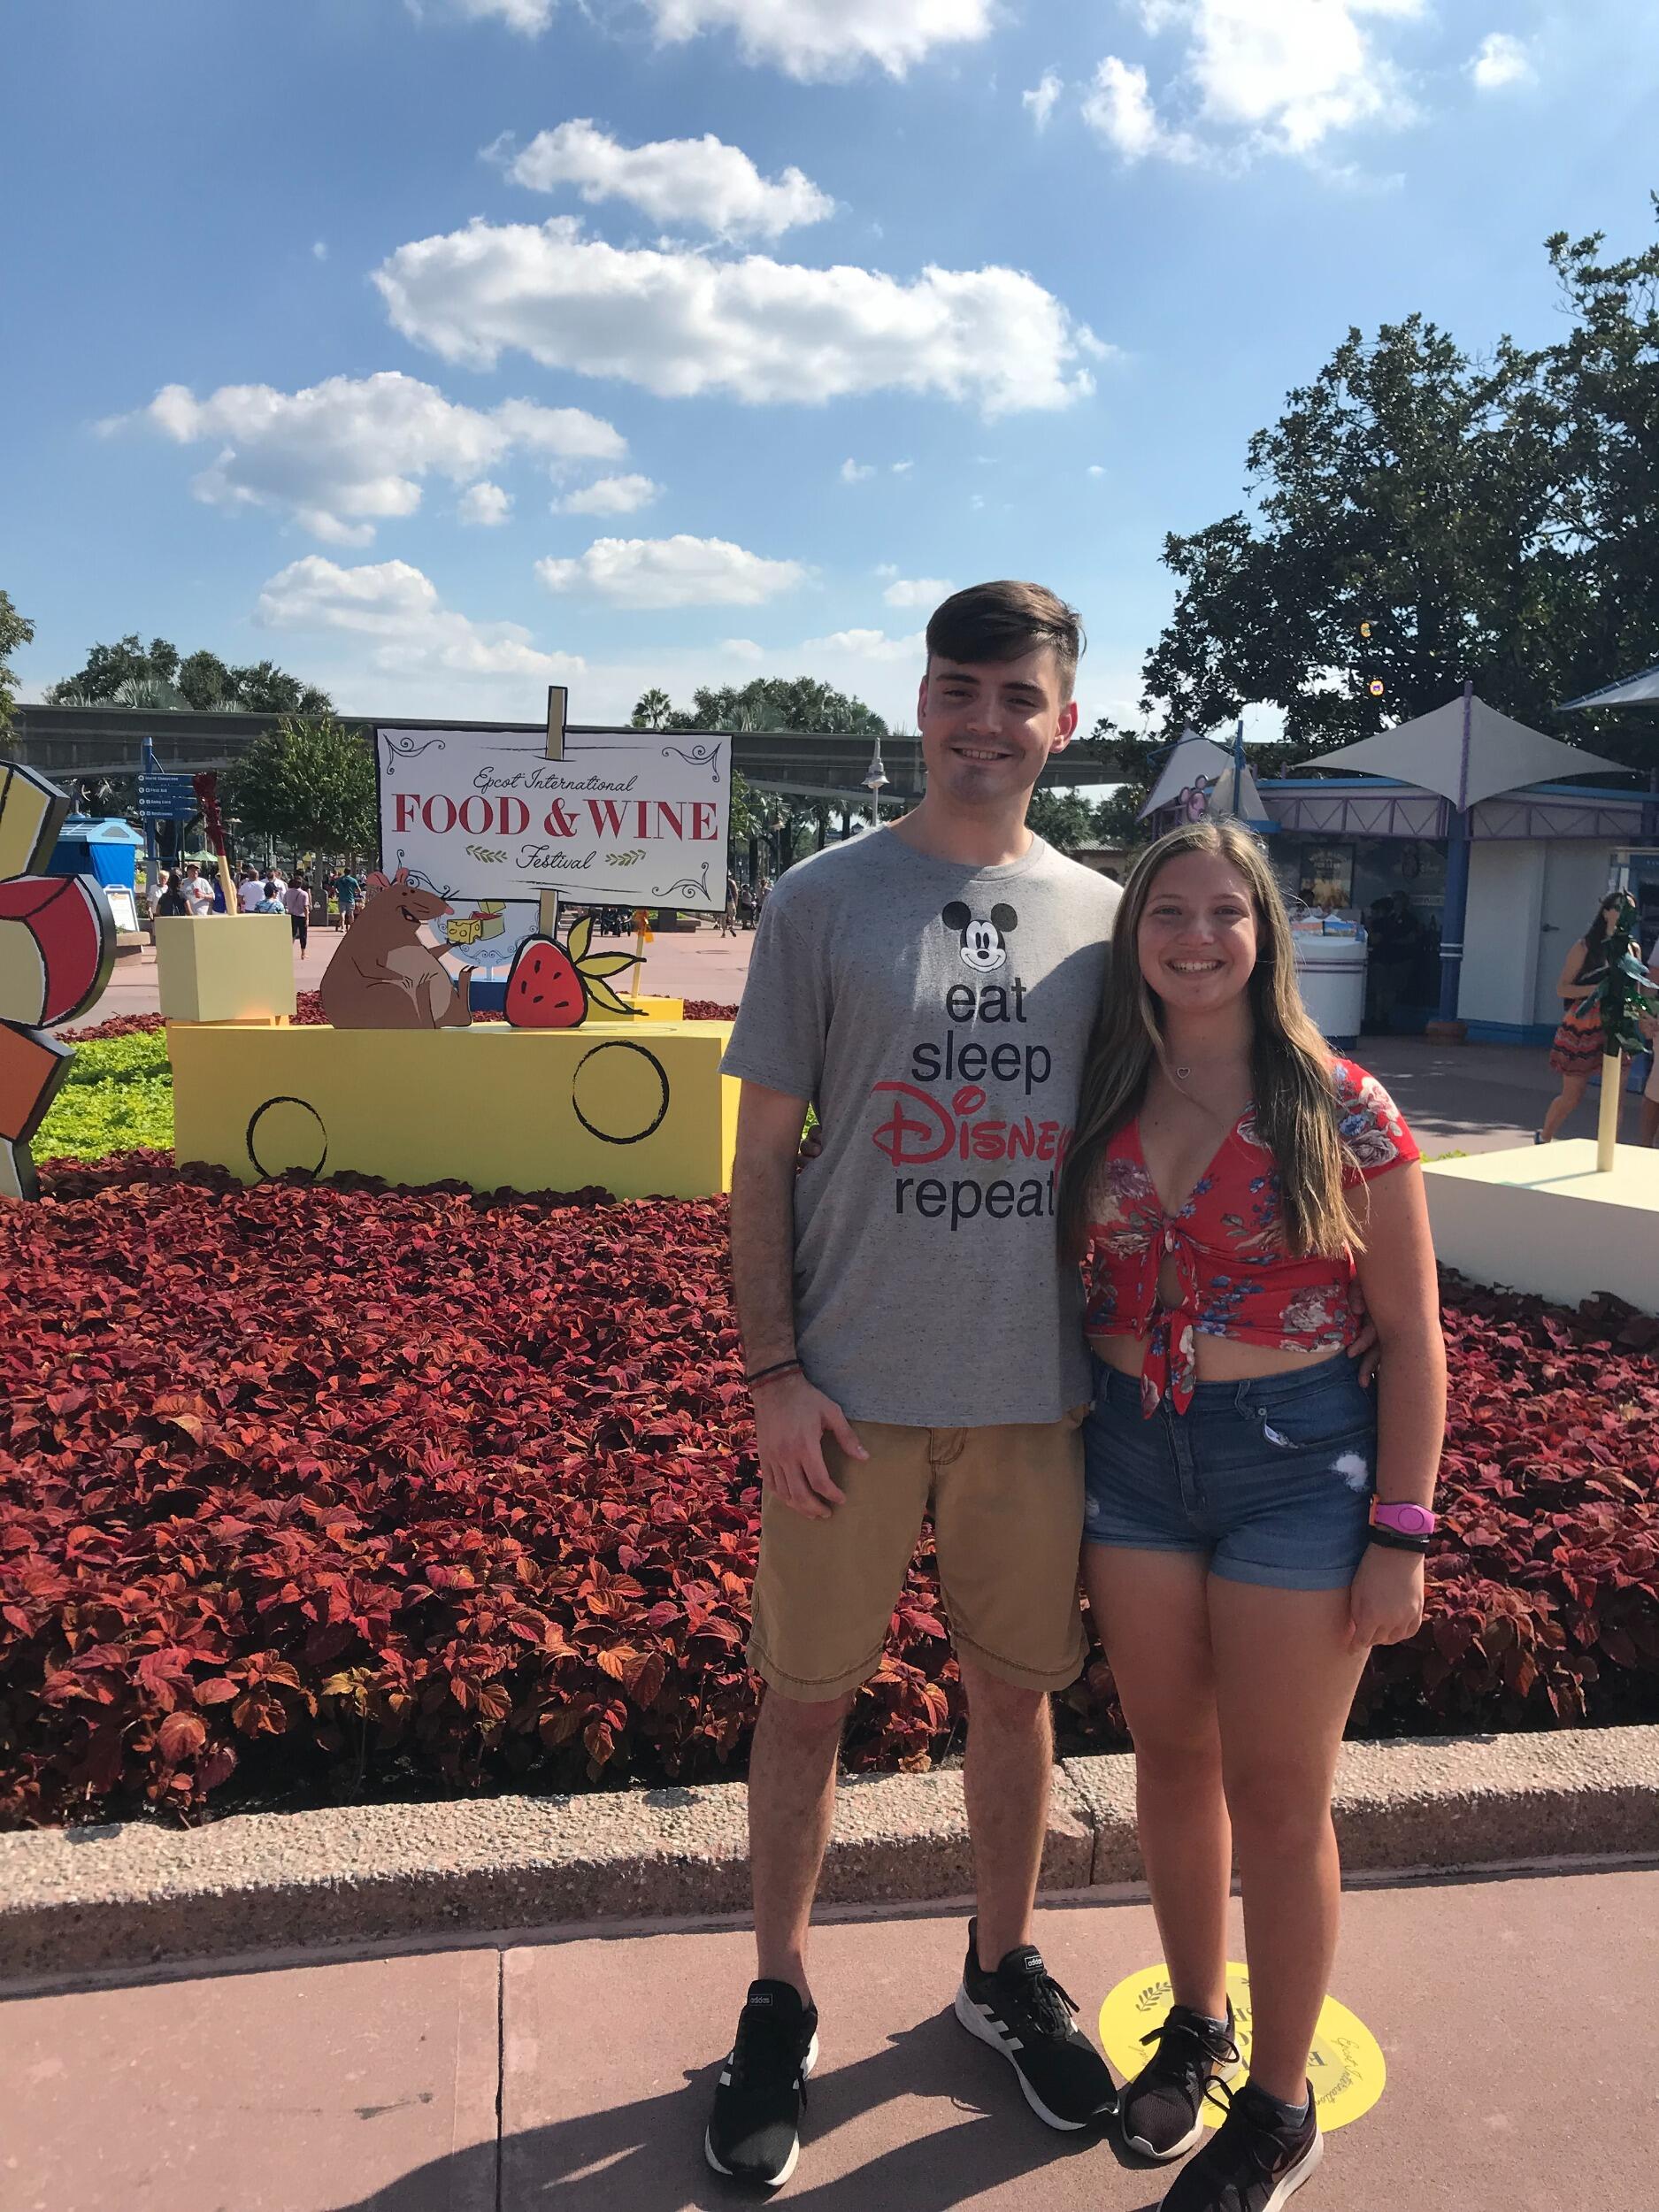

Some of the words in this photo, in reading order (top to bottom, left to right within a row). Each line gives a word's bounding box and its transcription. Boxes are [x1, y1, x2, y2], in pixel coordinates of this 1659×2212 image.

[473, 766, 525, 794] Epcot
[525, 766, 638, 792] International
[391, 793, 530, 835] FOOD
[543, 797, 581, 838] &
[583, 799, 718, 841] WINE
[516, 844, 597, 871] Festival
[946, 977, 1027, 1024] eat
[911, 1030, 1051, 1094] sleep
